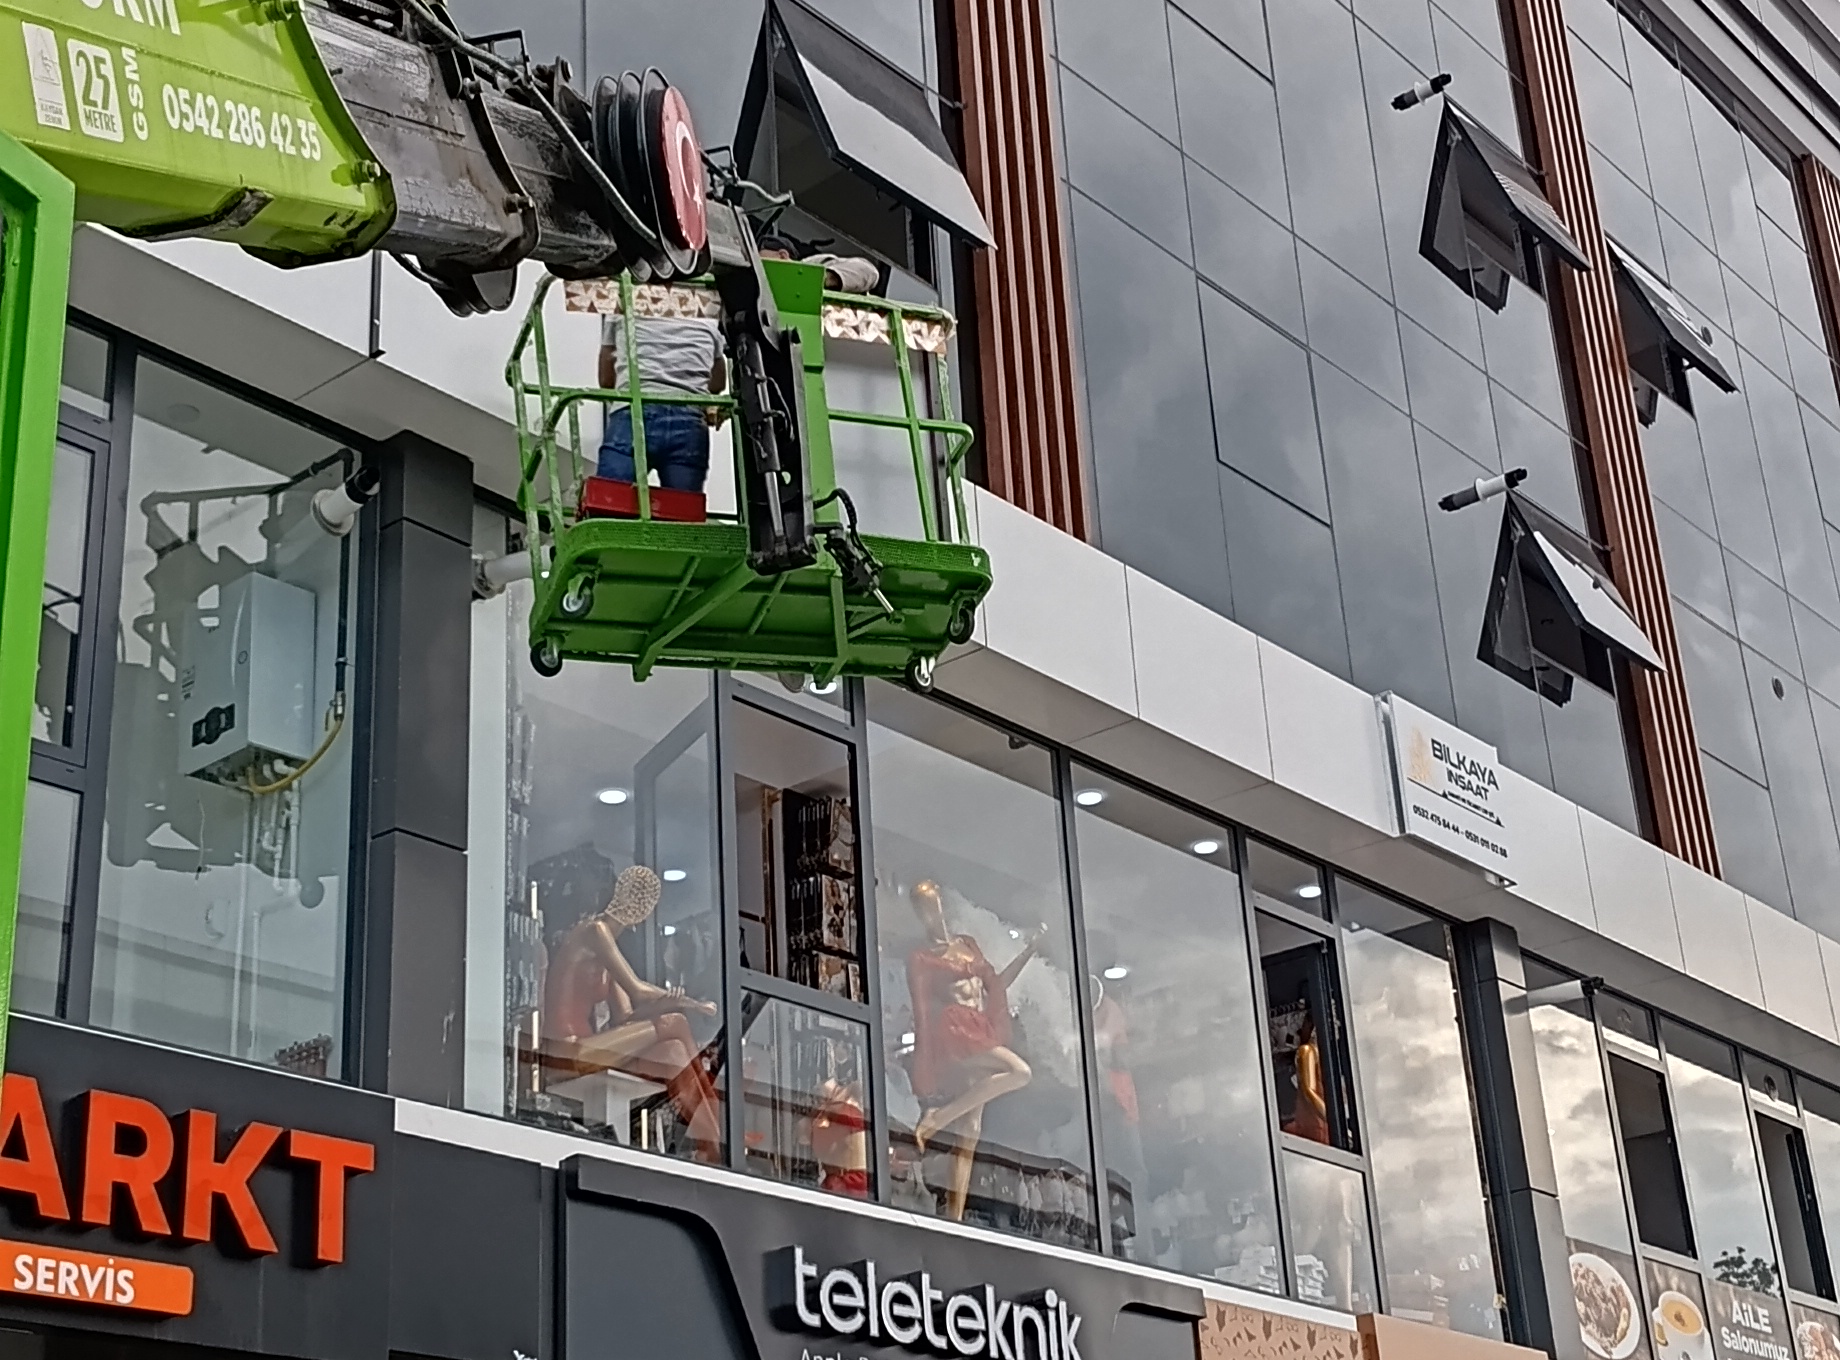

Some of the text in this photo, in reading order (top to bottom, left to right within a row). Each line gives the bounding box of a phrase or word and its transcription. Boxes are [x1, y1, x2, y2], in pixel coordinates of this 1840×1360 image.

[75, 49, 111, 111] 25
[121, 46, 149, 141] GSM
[83, 107, 118, 133] METRE
[162, 83, 322, 162] 0542 286 42 35
